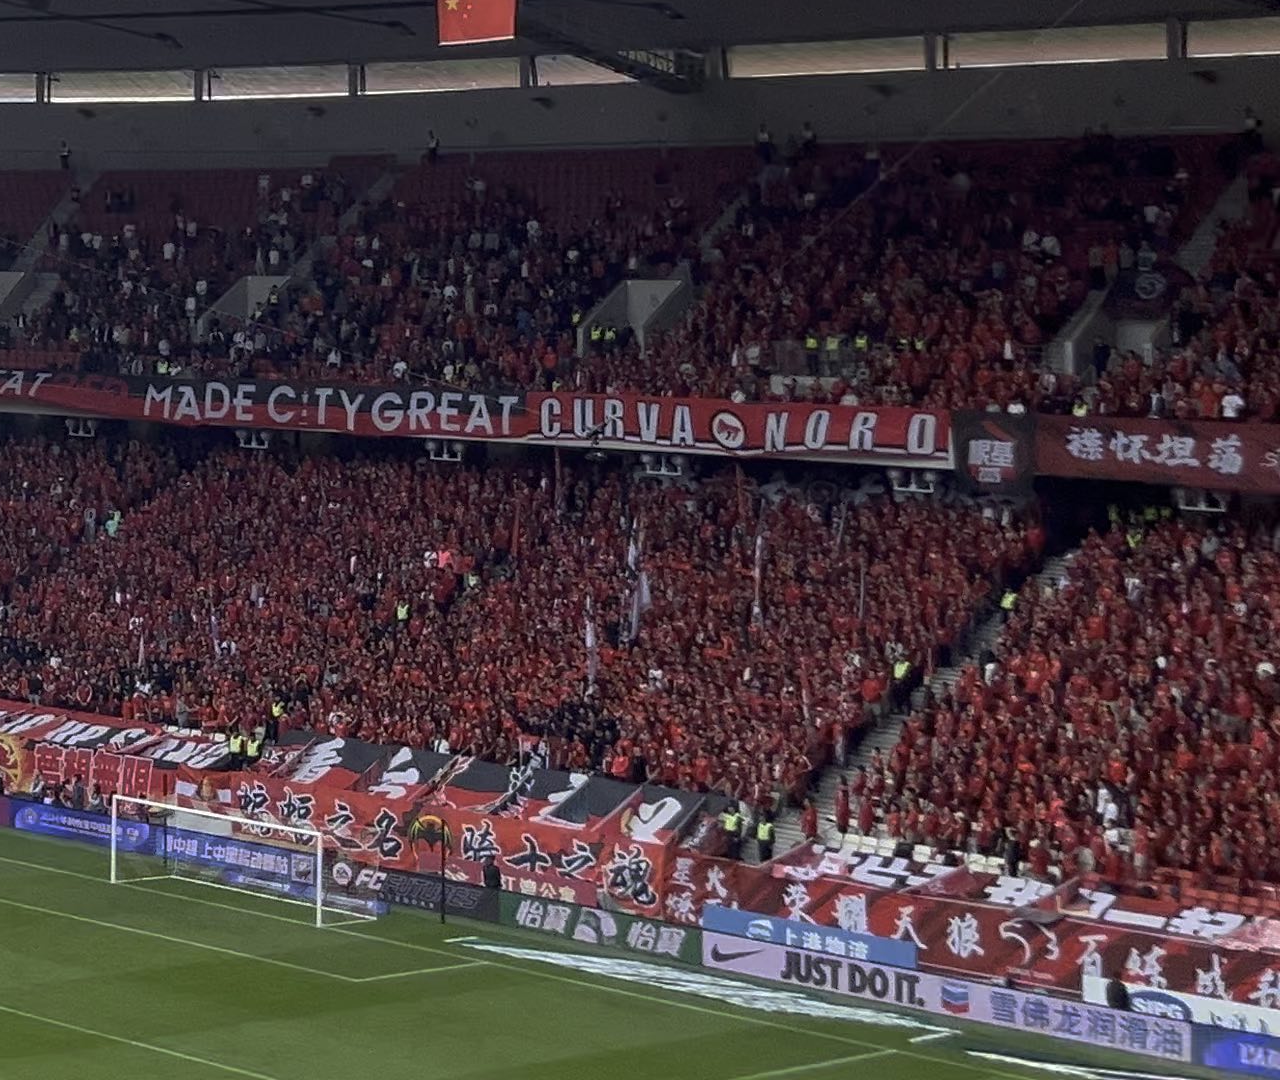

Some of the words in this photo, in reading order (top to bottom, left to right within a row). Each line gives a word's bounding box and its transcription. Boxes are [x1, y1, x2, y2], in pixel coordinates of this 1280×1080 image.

[143, 381, 257, 422] MADE
[371, 390, 519, 436] GREAT
[541, 397, 696, 447] CURVA
[764, 408, 937, 455] NORD
[355, 865, 388, 891] FC
[781, 950, 844, 991] JUST
[847, 963, 890, 999] DO
[894, 972, 926, 1008] IT.
[989, 990, 1185, 1058] 雪佛龙润滑油
